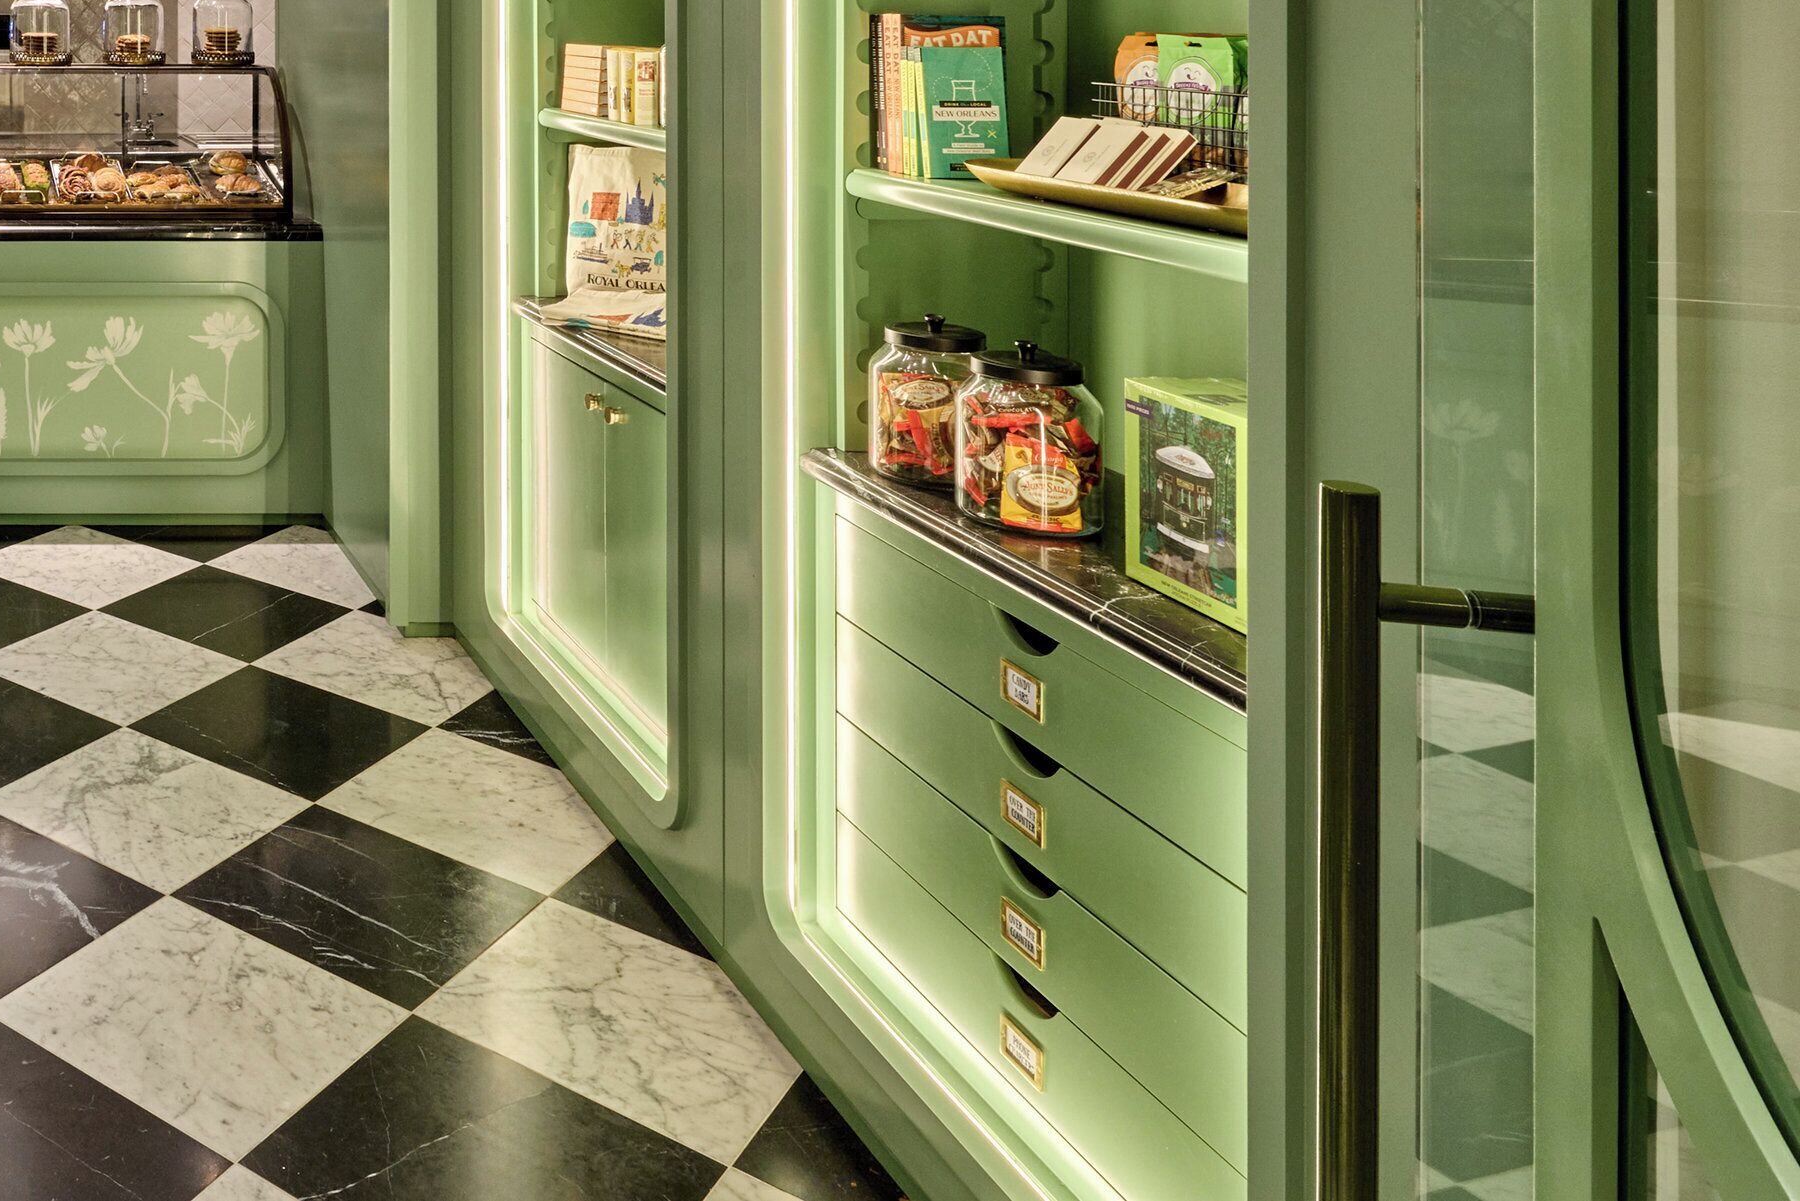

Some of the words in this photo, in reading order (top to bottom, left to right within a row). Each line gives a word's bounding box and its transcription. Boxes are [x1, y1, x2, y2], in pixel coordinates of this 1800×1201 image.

[951, 29, 993, 47] DAT
[935, 110, 955, 118] NEW
[956, 110, 998, 118] ORLEANS
[587, 273, 621, 288] ROYAL
[1011, 672, 1032, 694] CANDY
[1009, 795, 1024, 813] OVER
[1011, 808, 1036, 834] COUNTER
[1008, 913, 1023, 932] OVER
[1009, 926, 1035, 954] COUNTER
